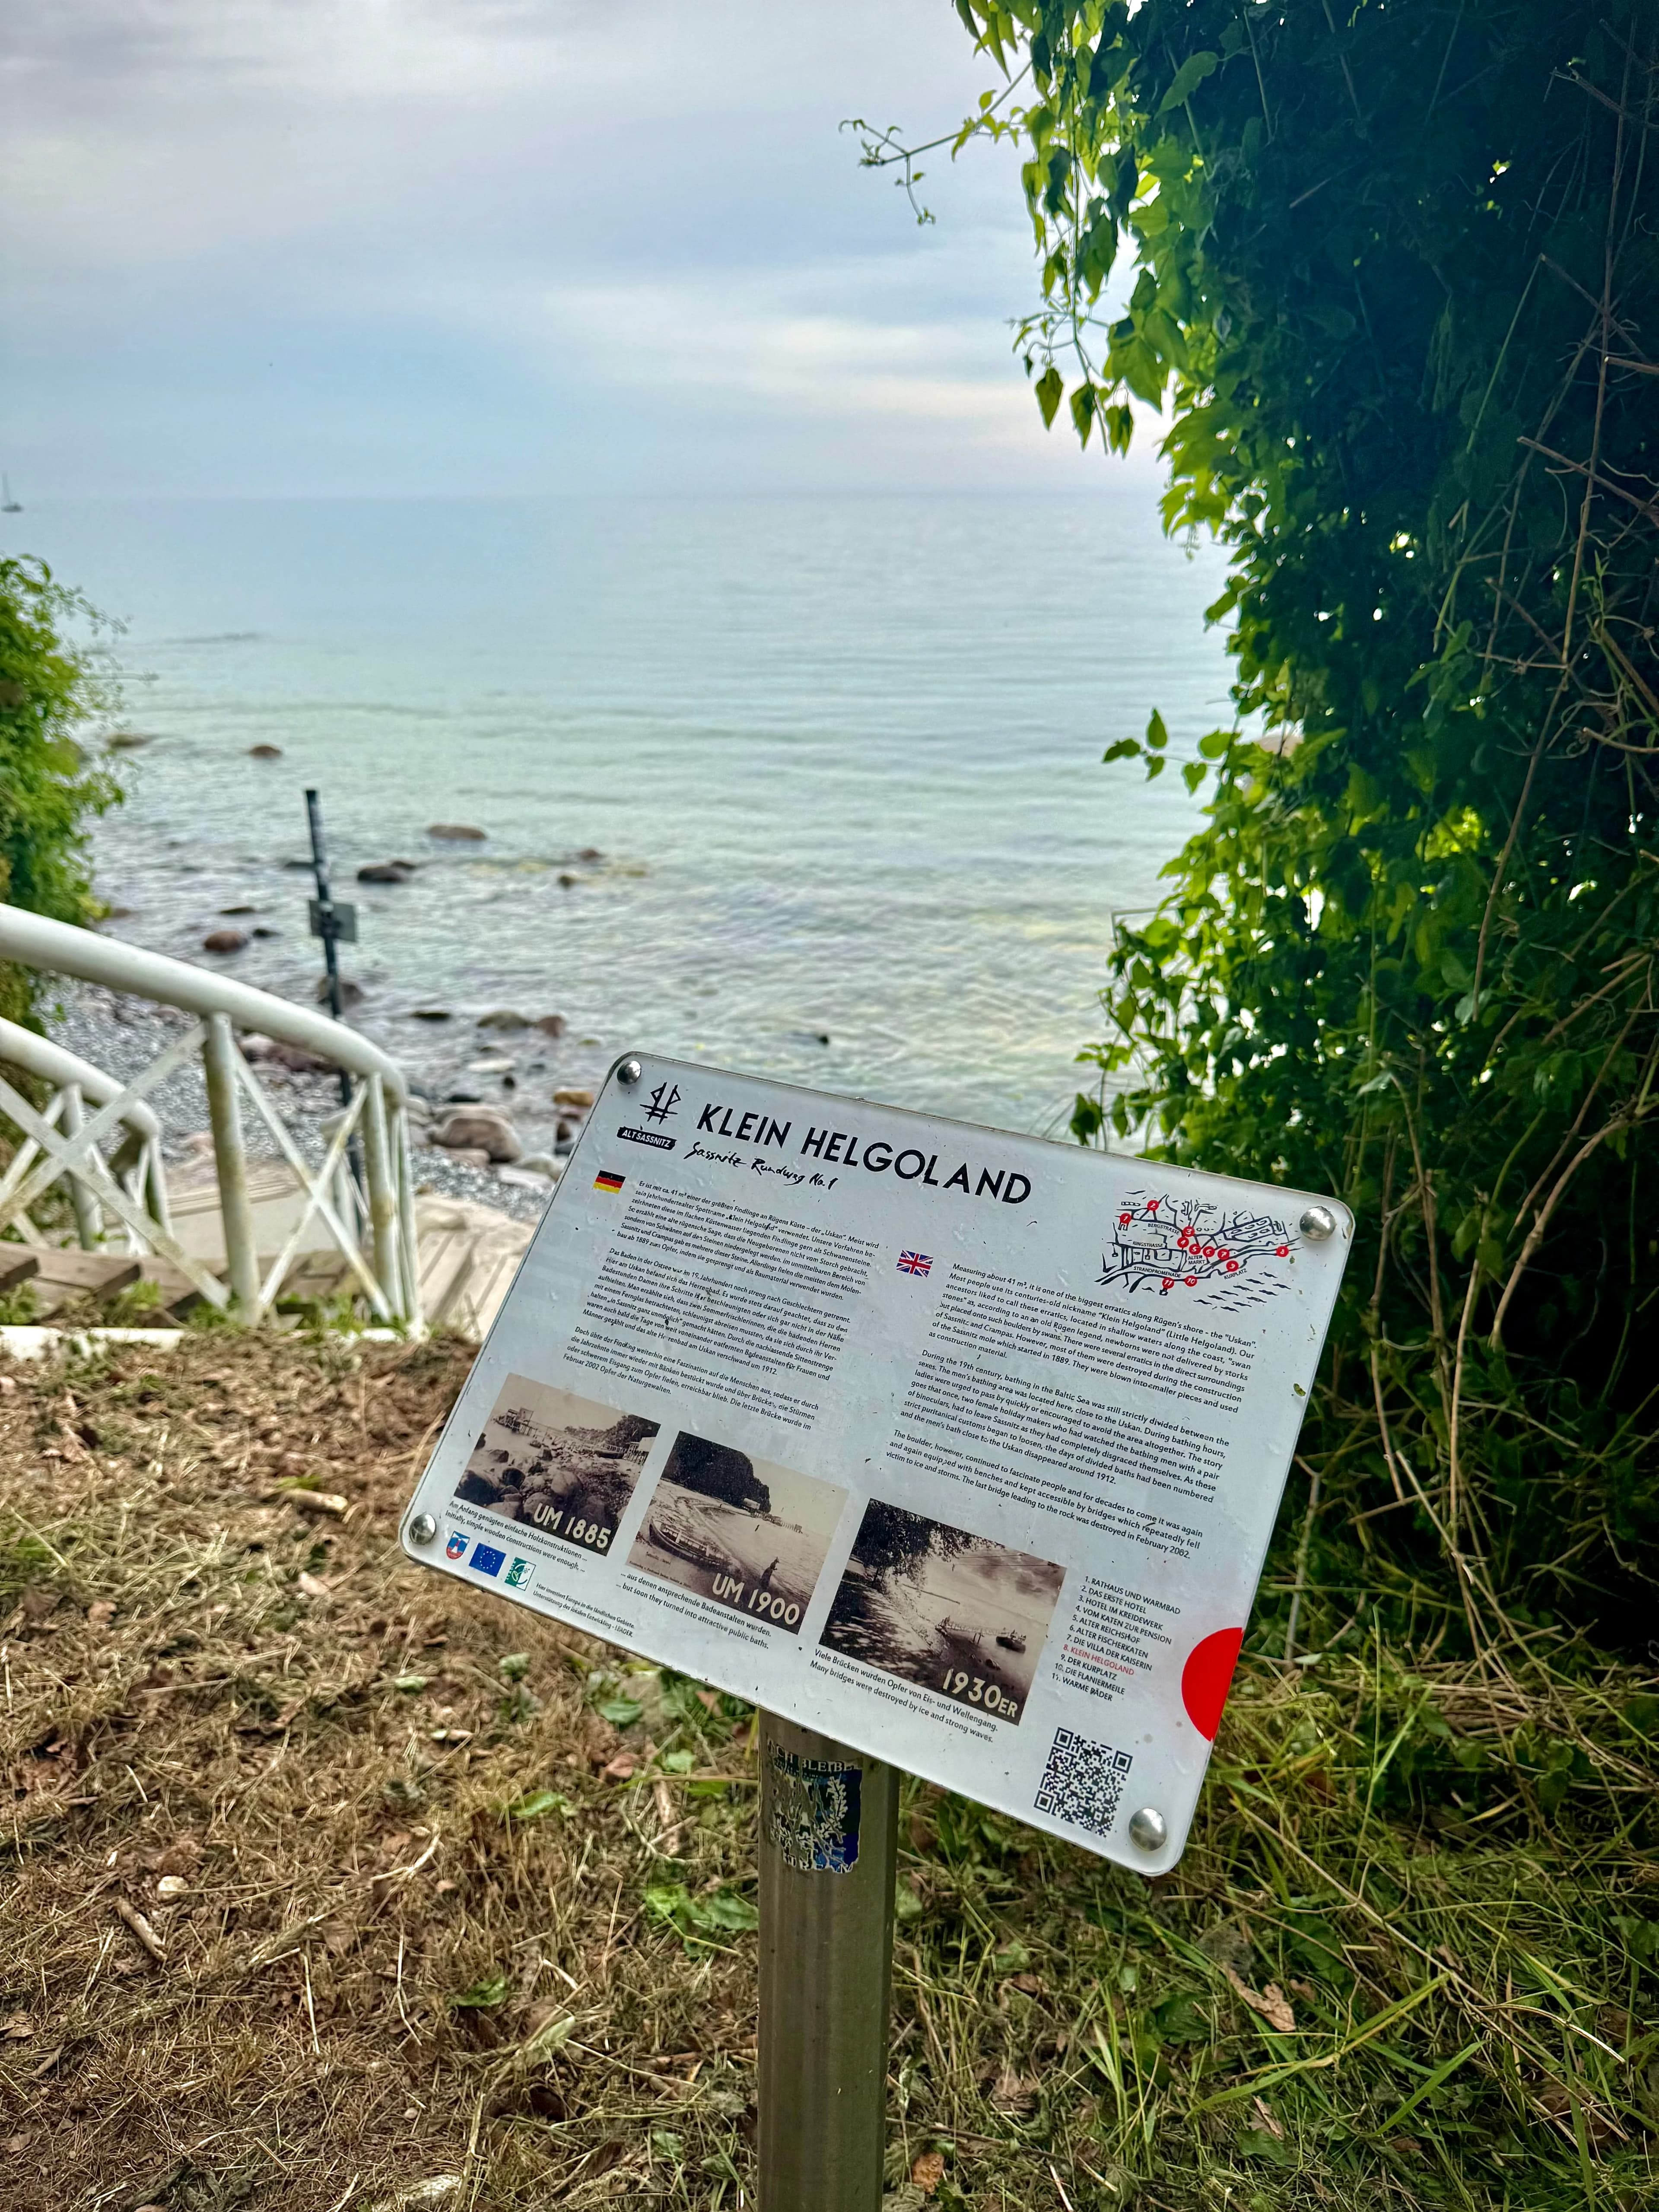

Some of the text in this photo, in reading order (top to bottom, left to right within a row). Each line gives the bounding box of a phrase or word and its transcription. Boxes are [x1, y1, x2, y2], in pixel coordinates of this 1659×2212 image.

[683, 1141, 746, 1167] Sassnitz
[751, 1158, 805, 1185] Rundweg
[697, 1103, 1030, 1203] KLEIN HELGOLAND
[1133, 1266, 1181, 1278] STRANDPROMENADE
[621, 1290, 644, 1302] Fernglas
[645, 1297, 680, 1314] betrachteten,
[682, 1310, 713, 1323] schleunigst
[714, 1320, 738, 1331] abreisen
[739, 1328, 763, 1340] mussten,
[795, 1344, 813, 1354] durch
[824, 1352, 836, 1360] Ver-
[922, 1349, 944, 1363] During
[960, 1361, 973, 1370] 19th
[976, 1367, 1002, 1380] century,
[1004, 1374, 1031, 1389] bathing
[1055, 1389, 1075, 1400] Baltic
[1076, 1395, 1090, 1405] Sea
[1122, 1411, 1148, 1424] strictly
[1149, 1417, 1179, 1431] divided
[1180, 1426, 1214, 1442] between
[1216, 1437, 1229, 1446] the
[928, 1385, 941, 1393] that
[942, 1391, 959, 1400] once,
[975, 1399, 998, 1411] female
[1000, 1406, 1025, 1421] holiday
[1026, 1416, 1051, 1427] makers
[1052, 1424, 1067, 1432] who
[1068, 1427, 1082, 1437] had
[1084, 1434, 1115, 1447] watched
[1116, 1443, 1128, 1452] the
[1160, 1458, 1176, 1467] men
[1179, 1464, 1195, 1472] with
[445, 1510, 465, 1524] Initially,
[466, 1519, 483, 1530] simple
[484, 1527, 505, 1539] wooden
[506, 1535, 542, 1554] constructions
[543, 1551, 556, 1560] were
[457, 1505, 478, 1518] Anfang
[477, 1514, 504, 1527] genügten
[504, 1524, 528, 1536] einfache
[528, 1532, 581, 1558] Holzkonstruktionen
[534, 1503, 610, 1548] UM 1885
[622, 1582, 768, 1649] but soon they turned into attractive public baths.
[638, 1577, 657, 1589] denen
[658, 1586, 700, 1607] ansprechende
[701, 1602, 744, 1625] Badeanstalten
[746, 1622, 771, 1637] wurden.
[712, 1573, 744, 1602] UM
[748, 1589, 799, 1624] 1900
[1085, 1597, 1106, 1611] HOTEL
[1119, 1609, 1163, 1630] KREIDEWERK
[1088, 1588, 1103, 1597] DAS
[1103, 1593, 1123, 1605] ERSTE
[1124, 1600, 1146, 1614] HOTEL
[1091, 1578, 1123, 1594] RATHAUS
[1125, 1590, 1141, 1600] UND
[1143, 1596, 1180, 1614] WARMBAD
[1076, 1627, 1096, 1639] ALTER
[1097, 1634, 1148, 1658] FISCHERKATEN
[1079, 1617, 1100, 1629] ALTER
[1100, 1624, 1140, 1643] REICHSHOF
[1083, 1607, 1099, 1618] VOM
[1100, 1614, 1123, 1627] KATEN
[1124, 1622, 1138, 1633] ZUR
[1140, 1628, 1171, 1644] PENSION
[1067, 1656, 1081, 1667] DER
[1082, 1662, 1117, 1680] KURPLATZ
[1071, 1646, 1090, 1659] KLEIN
[1091, 1654, 1134, 1675] HELGOLAND
[1073, 1637, 1085, 1646] DIE
[1087, 1641, 1104, 1653] VILLA
[1106, 1649, 1119, 1659] DER
[1120, 1654, 1152, 1671] KAISERIN
[810, 1660, 992, 1742] Many bridges were destroyed by ice and strong waves.
[815, 1648, 997, 1732] Viele Brücken wurden Opfer von Eis- und Wellengang.
[943, 1669, 1017, 1717] 1930ER
[1063, 1676, 1089, 1692] WARME
[1065, 1667, 1077, 1676] DIE
[1077, 1671, 1125, 1694] FLANIERMEILE
